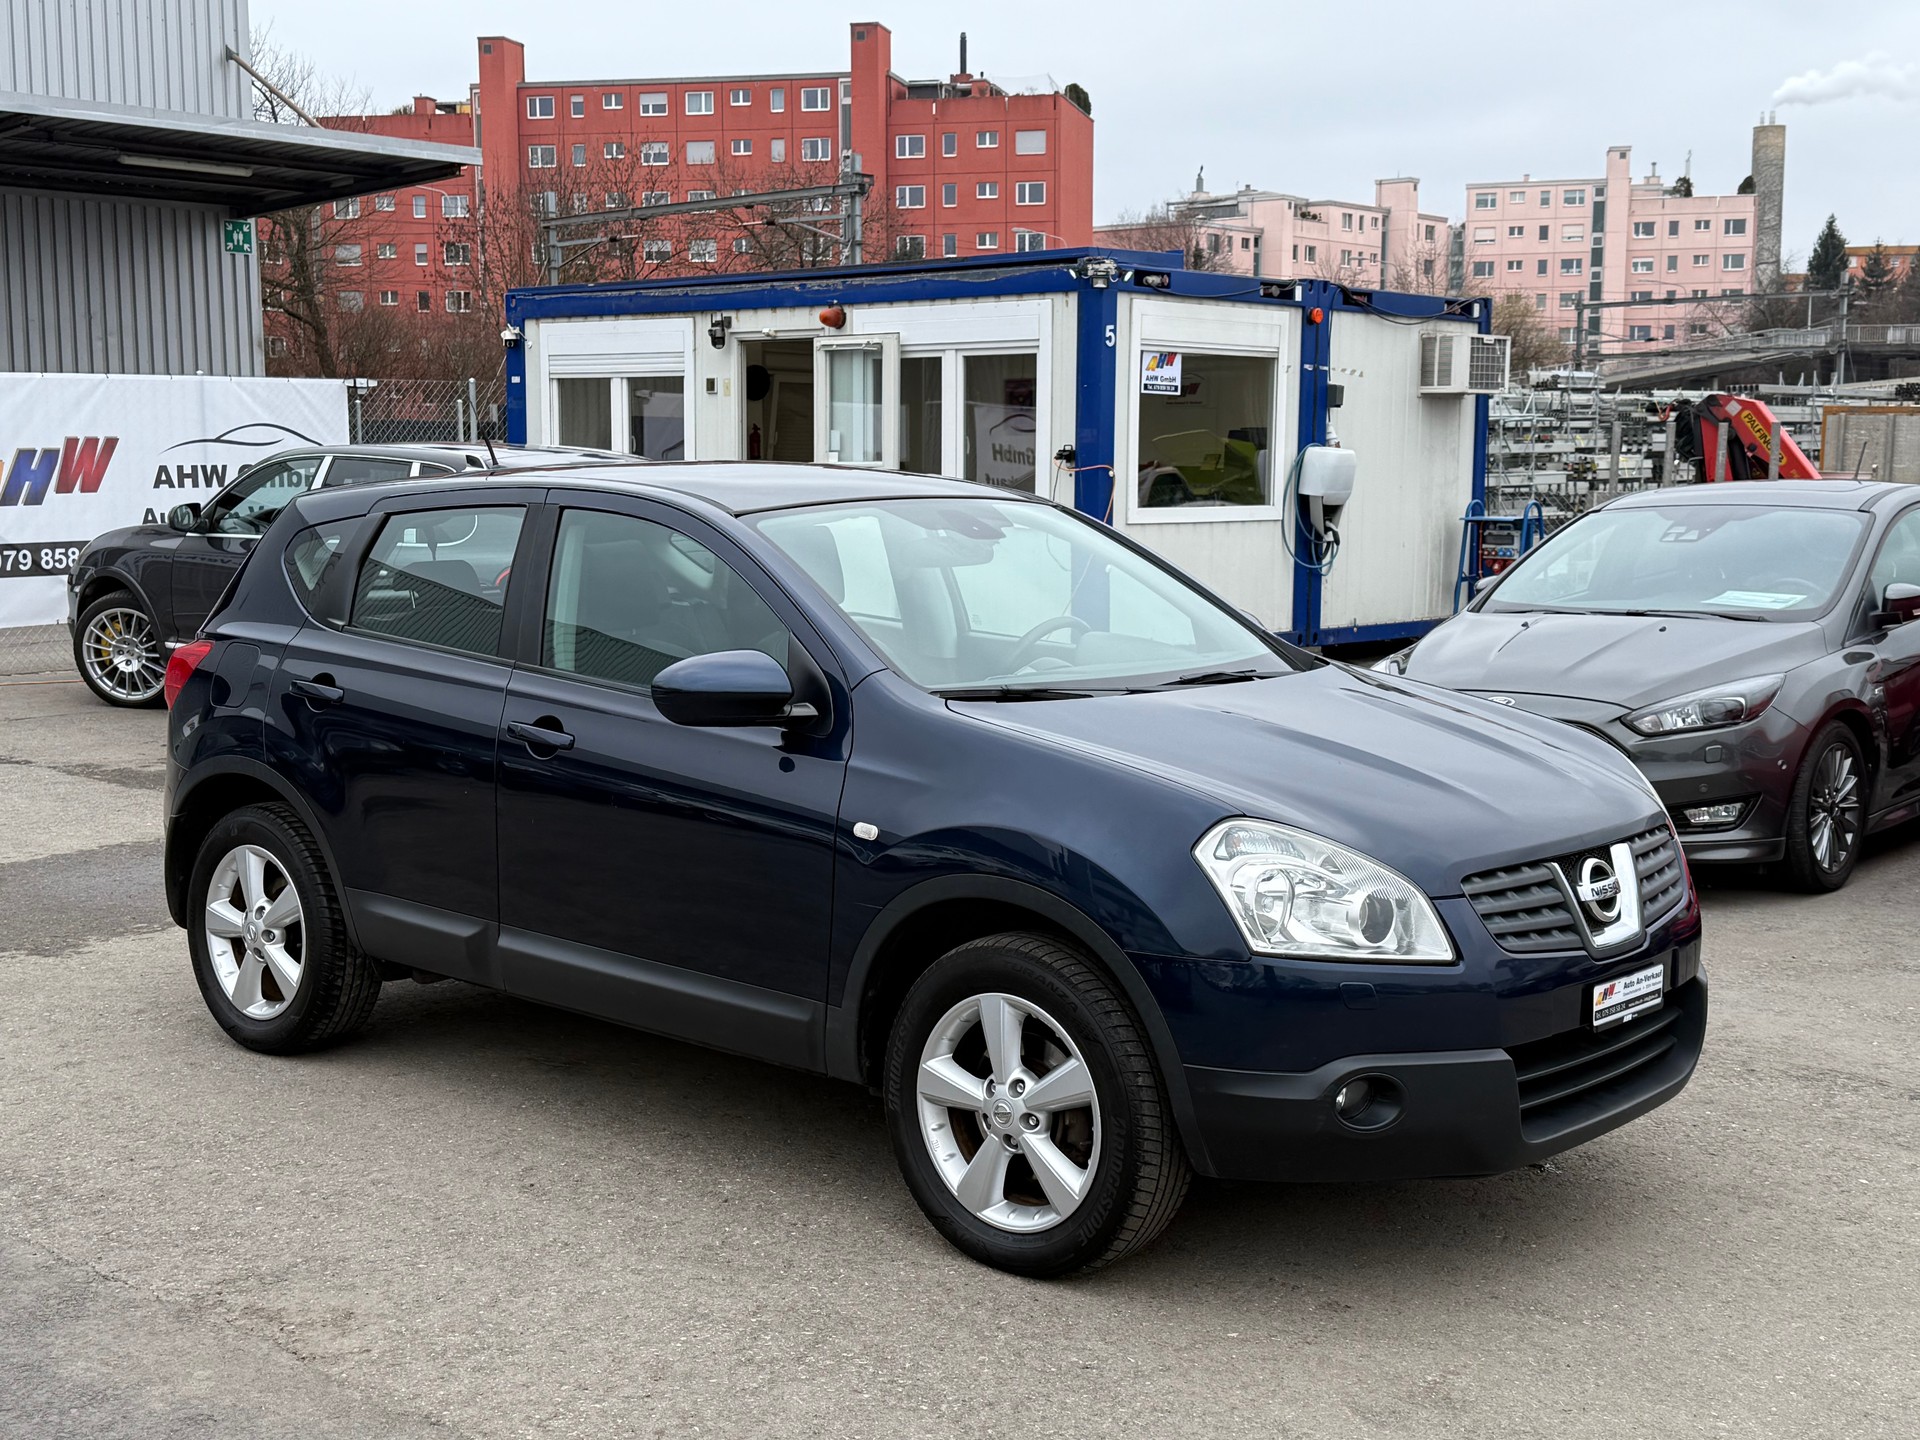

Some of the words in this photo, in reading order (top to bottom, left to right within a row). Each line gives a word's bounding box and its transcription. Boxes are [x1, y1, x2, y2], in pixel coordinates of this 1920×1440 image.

[1105, 324, 1116, 347] 5
[1145, 352, 1178, 371] AHW
[1145, 374, 1159, 382] AHW
[1159, 375, 1177, 383] GmbH
[0, 436, 119, 506] HW
[153, 464, 227, 488] AHW
[0, 549, 32, 571] 79
[1623, 980, 1635, 990] Auto
